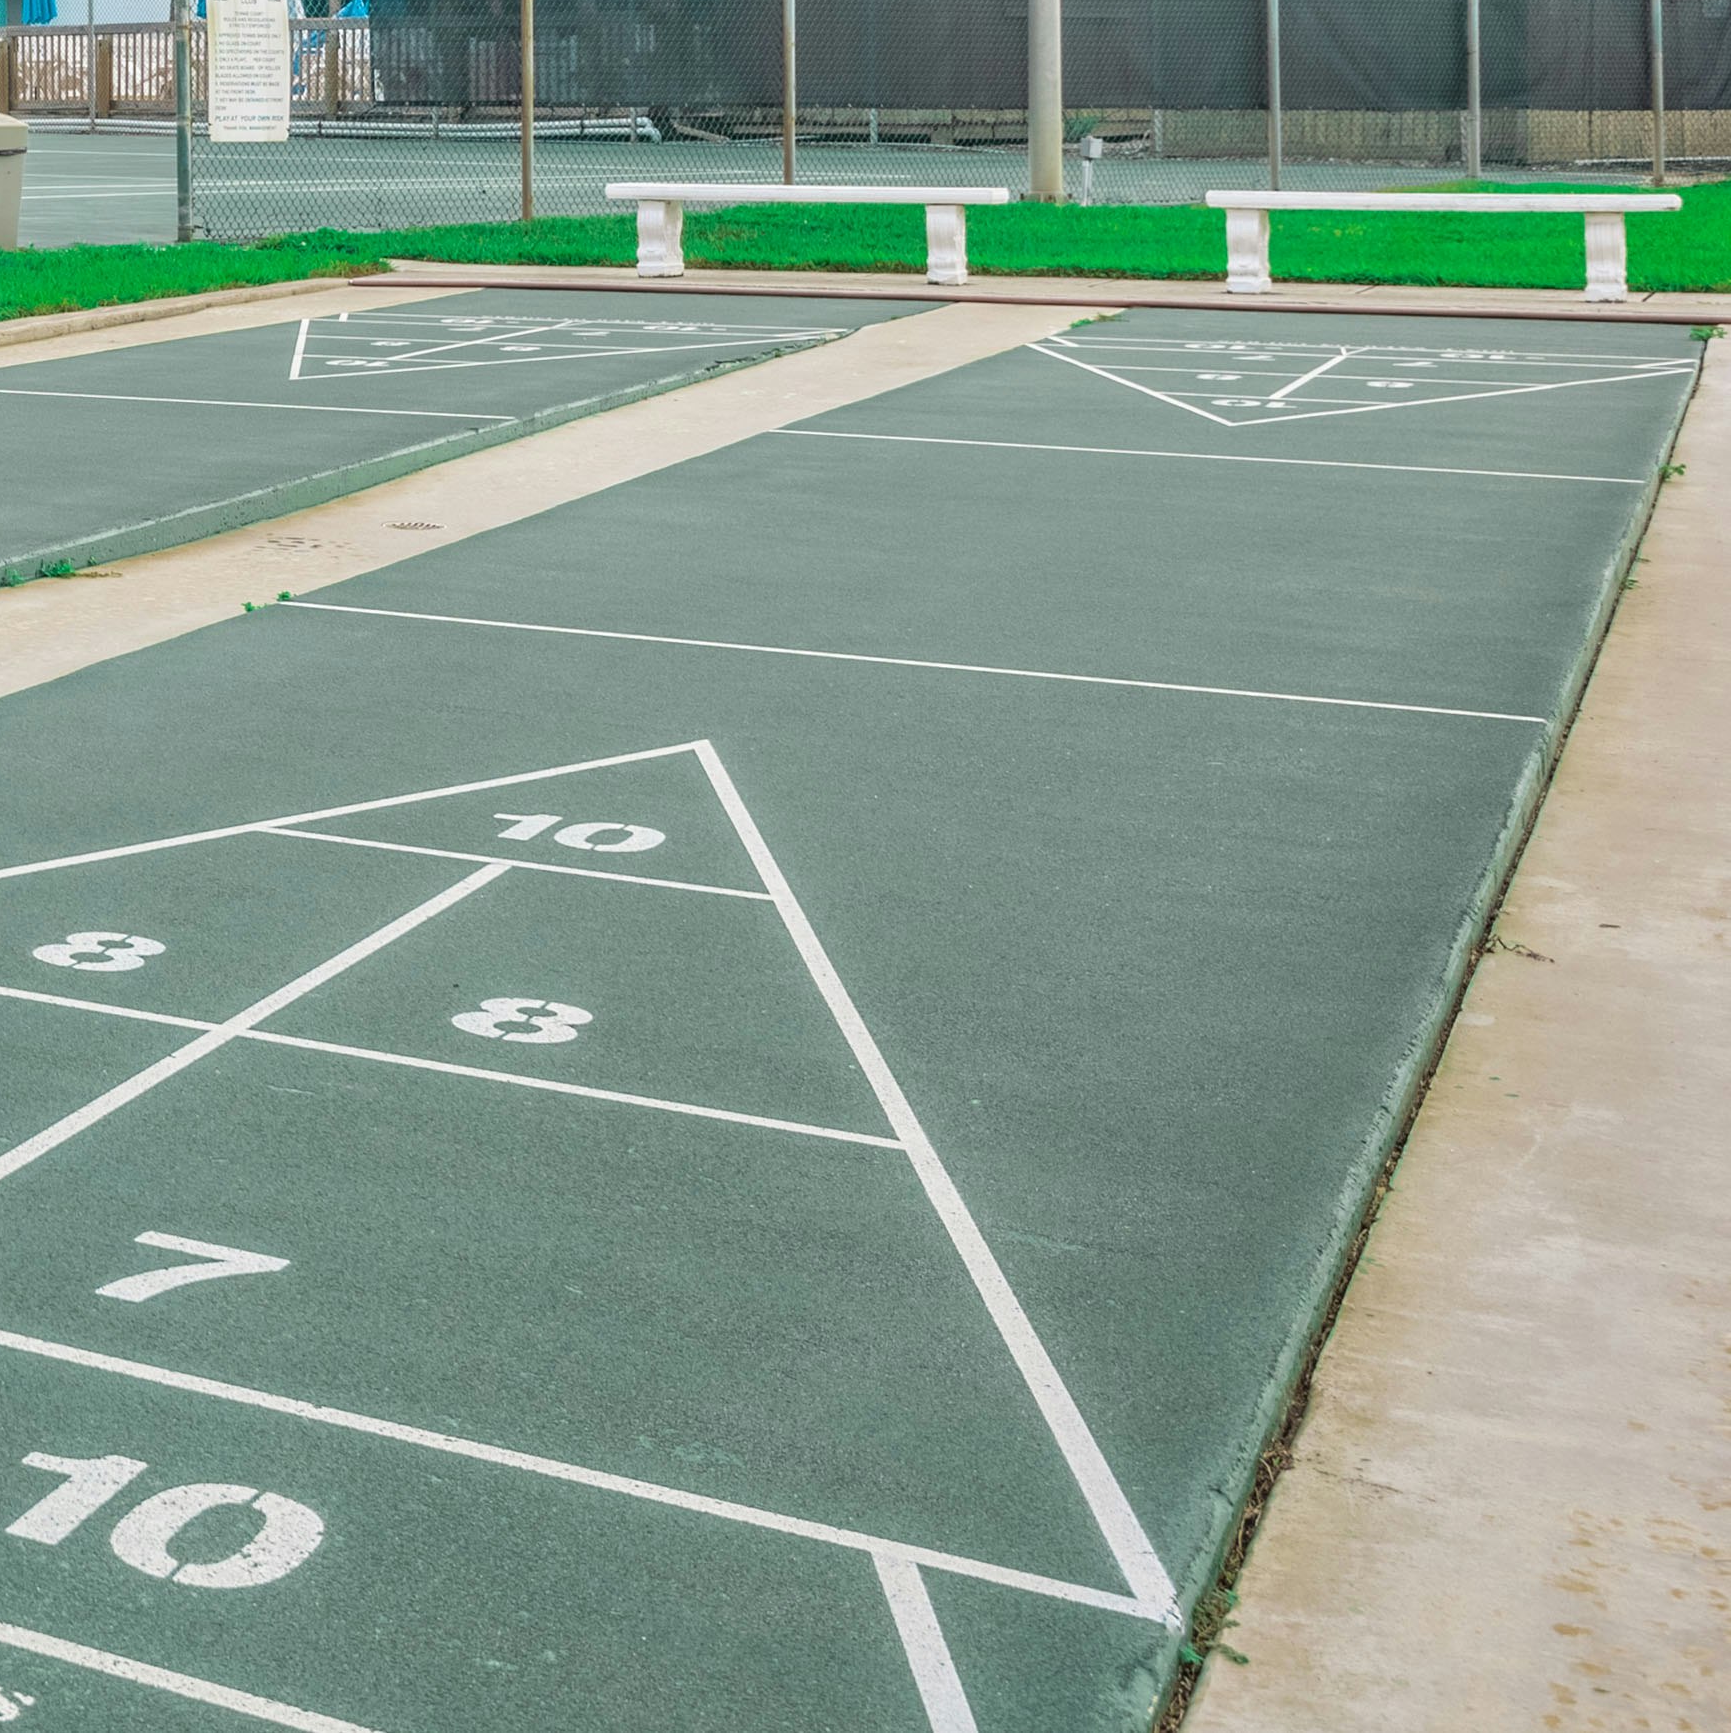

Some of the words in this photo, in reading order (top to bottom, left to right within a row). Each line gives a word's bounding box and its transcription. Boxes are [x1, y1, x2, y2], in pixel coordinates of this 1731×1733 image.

[493, 812, 667, 853] 10
[32, 930, 166, 972] 8
[451, 997, 594, 1044] 8
[94, 1230, 292, 1303] 7
